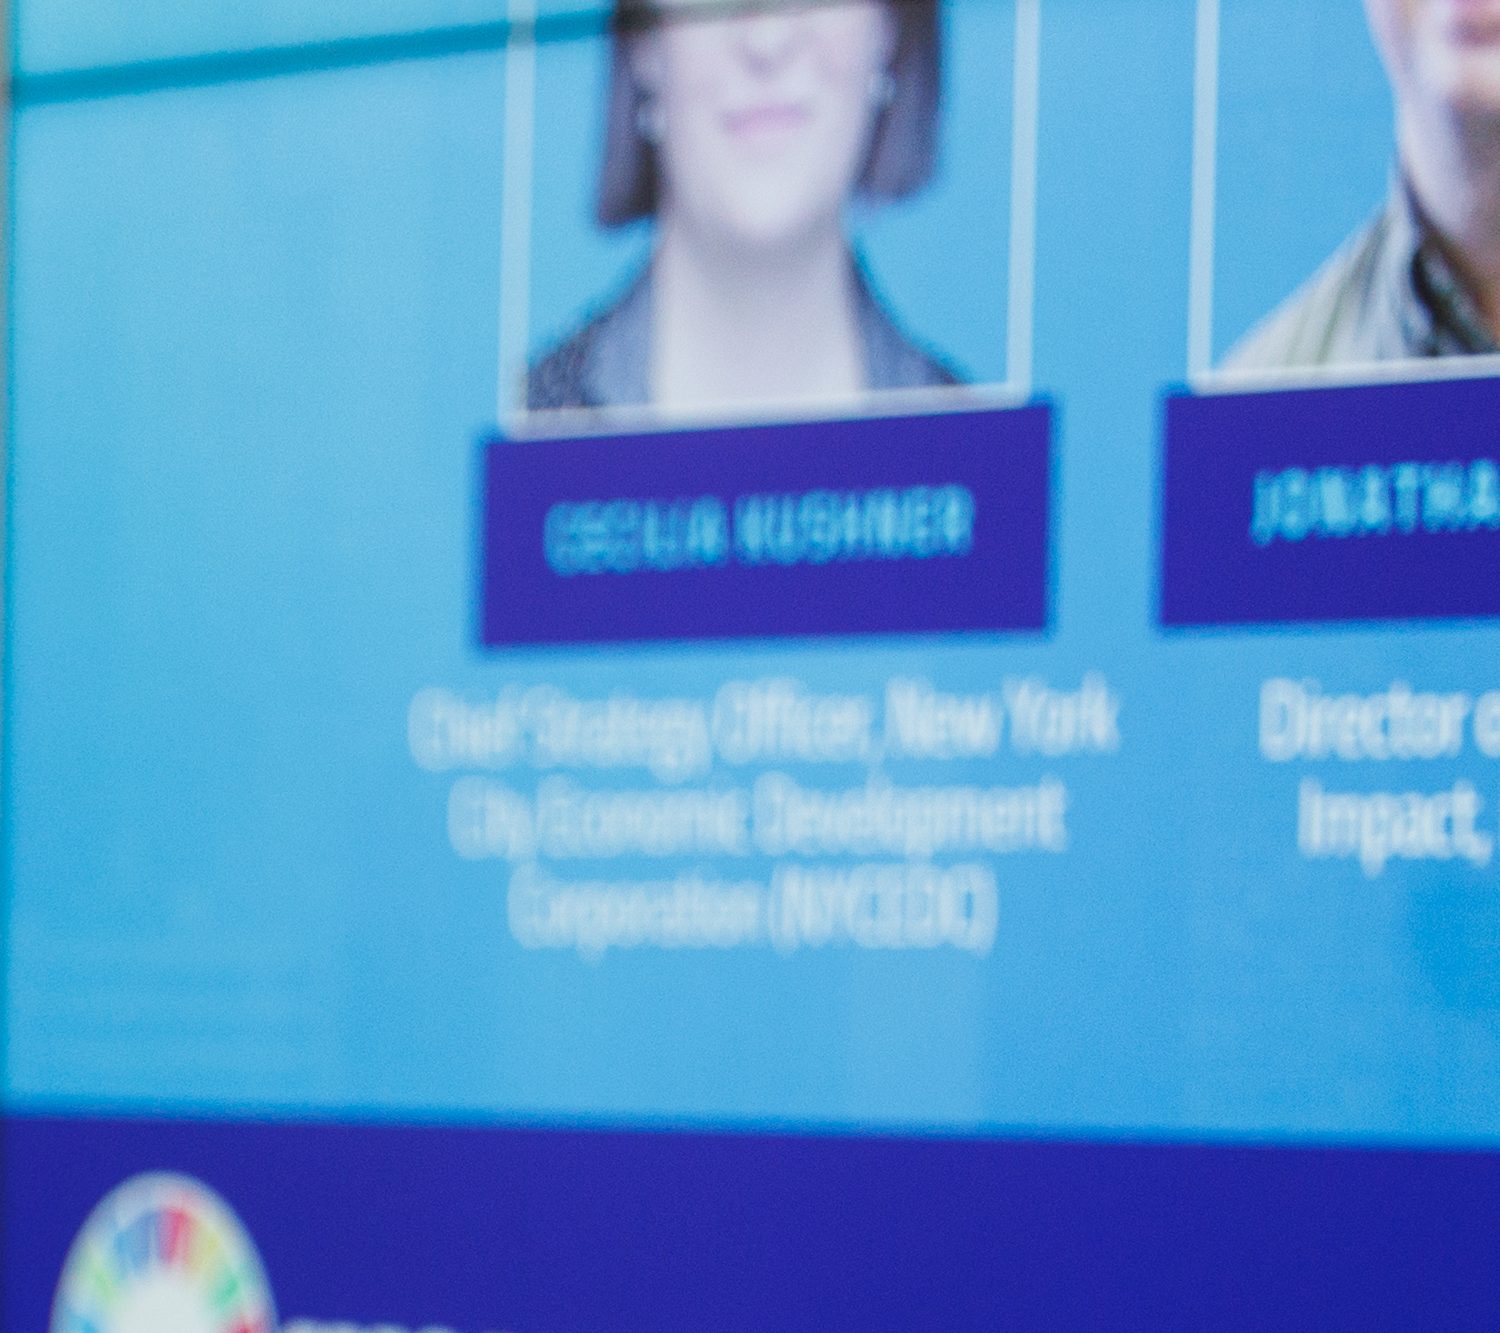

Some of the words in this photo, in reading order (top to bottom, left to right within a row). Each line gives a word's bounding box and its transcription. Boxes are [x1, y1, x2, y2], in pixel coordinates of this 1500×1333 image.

[543, 495, 728, 577] CECILIA
[733, 483, 975, 567] KUSHNER
[408, 684, 524, 771] Chief
[522, 682, 713, 783] Strategy
[885, 676, 999, 759] New
[1001, 672, 1121, 757] York
[1260, 678, 1469, 761] Director
[448, 775, 537, 868] City
[536, 774, 752, 859] Economic
[754, 771, 1068, 865] Development
[1298, 777, 1492, 877] Impact,
[508, 862, 764, 962] Corporation
